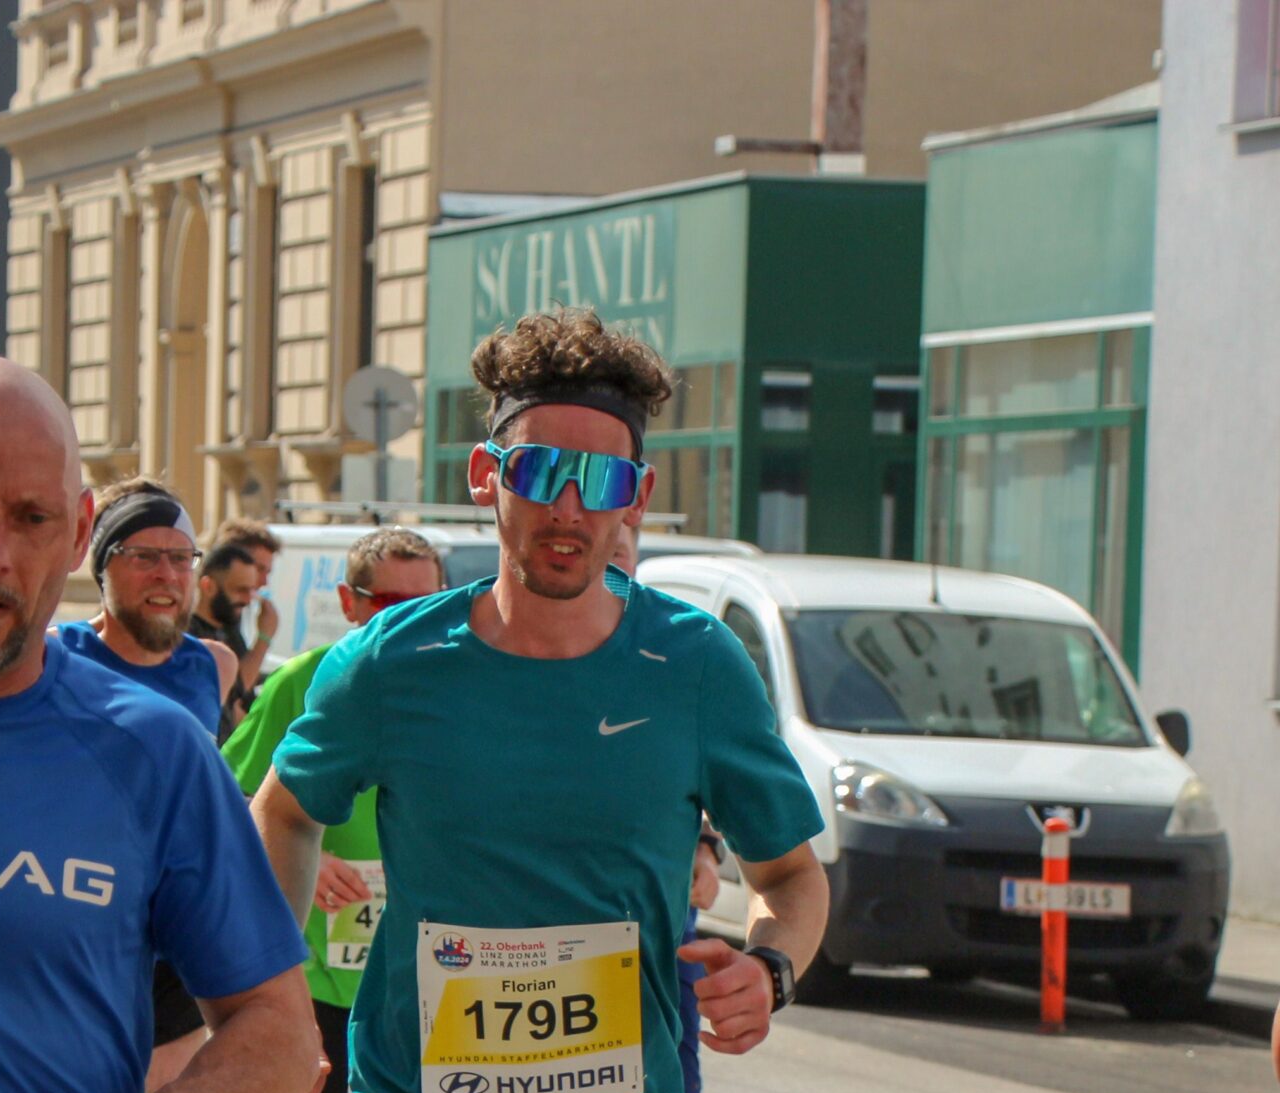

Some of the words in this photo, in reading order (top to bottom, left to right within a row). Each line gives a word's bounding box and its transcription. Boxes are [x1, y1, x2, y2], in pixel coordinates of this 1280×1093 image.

[477, 213, 668, 320] SCHANTL
[497, 941, 545, 951] Oberbank
[480, 951, 502, 960] LINZ
[508, 951, 547, 960] DONAU
[480, 960, 547, 968] MARATHON
[501, 979, 556, 993] Florian
[464, 993, 598, 1041] 179B
[439, 1055, 494, 1063] HYUNDAI
[500, 1039, 624, 1063] STAFFELMARATHON
